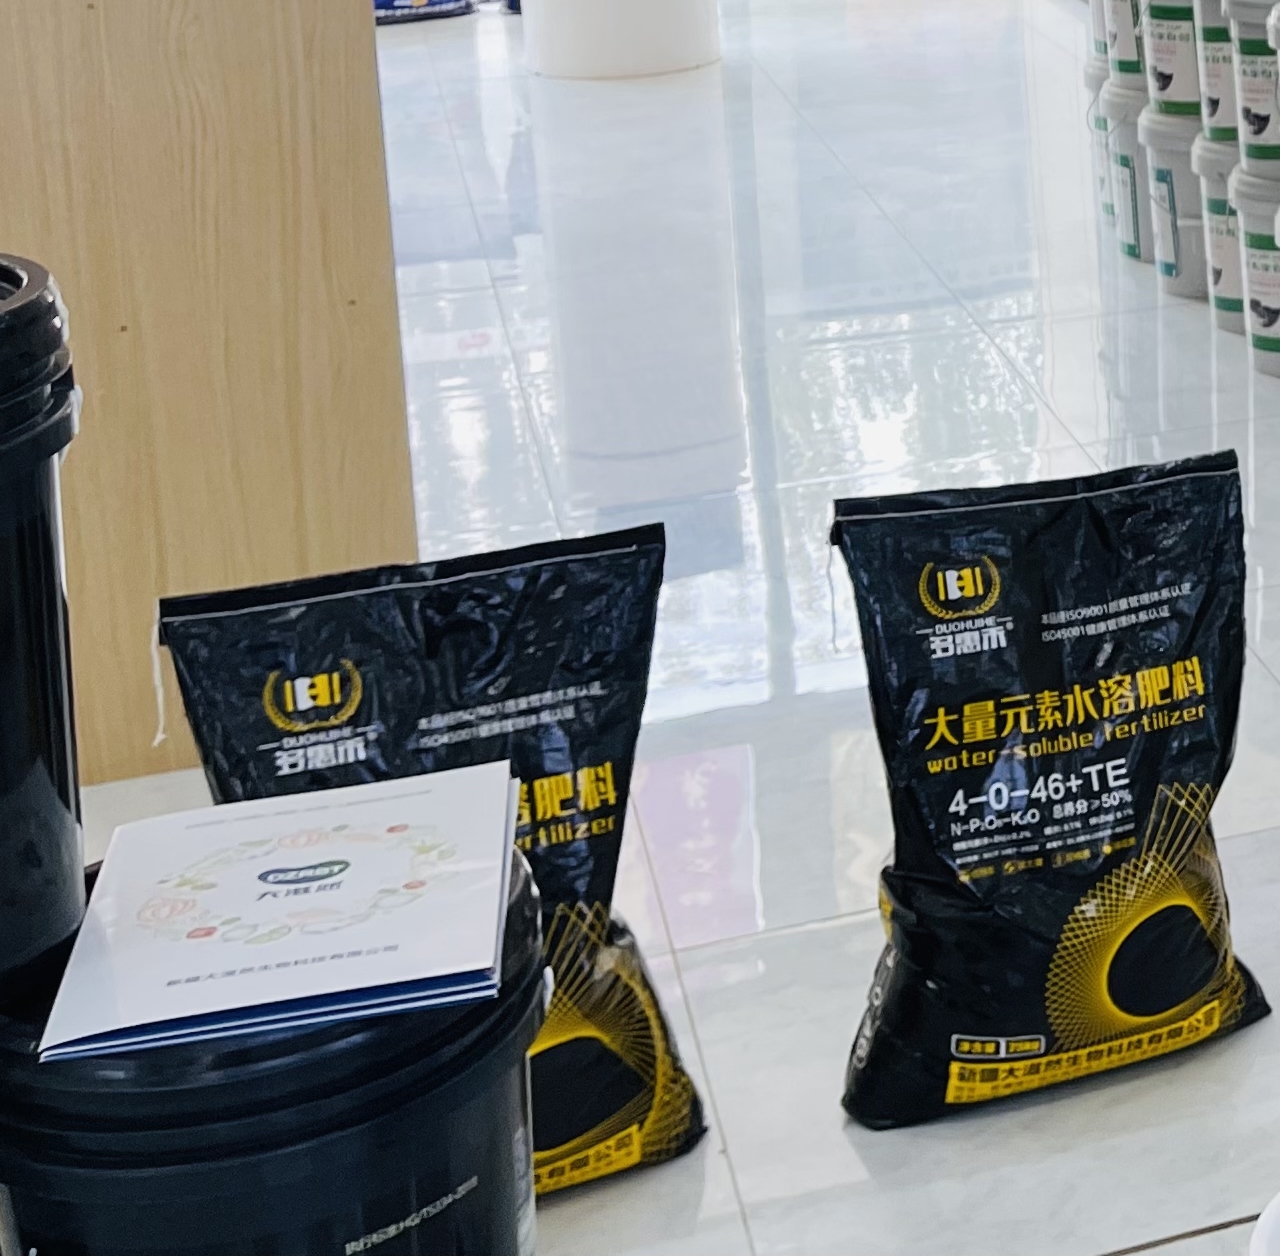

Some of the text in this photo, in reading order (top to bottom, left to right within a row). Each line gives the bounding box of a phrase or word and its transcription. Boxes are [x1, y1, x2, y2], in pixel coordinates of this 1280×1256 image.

[924, 655, 1206, 750] 大量元素水溶肥料
[1104, 704, 1207, 743] fertilizer
